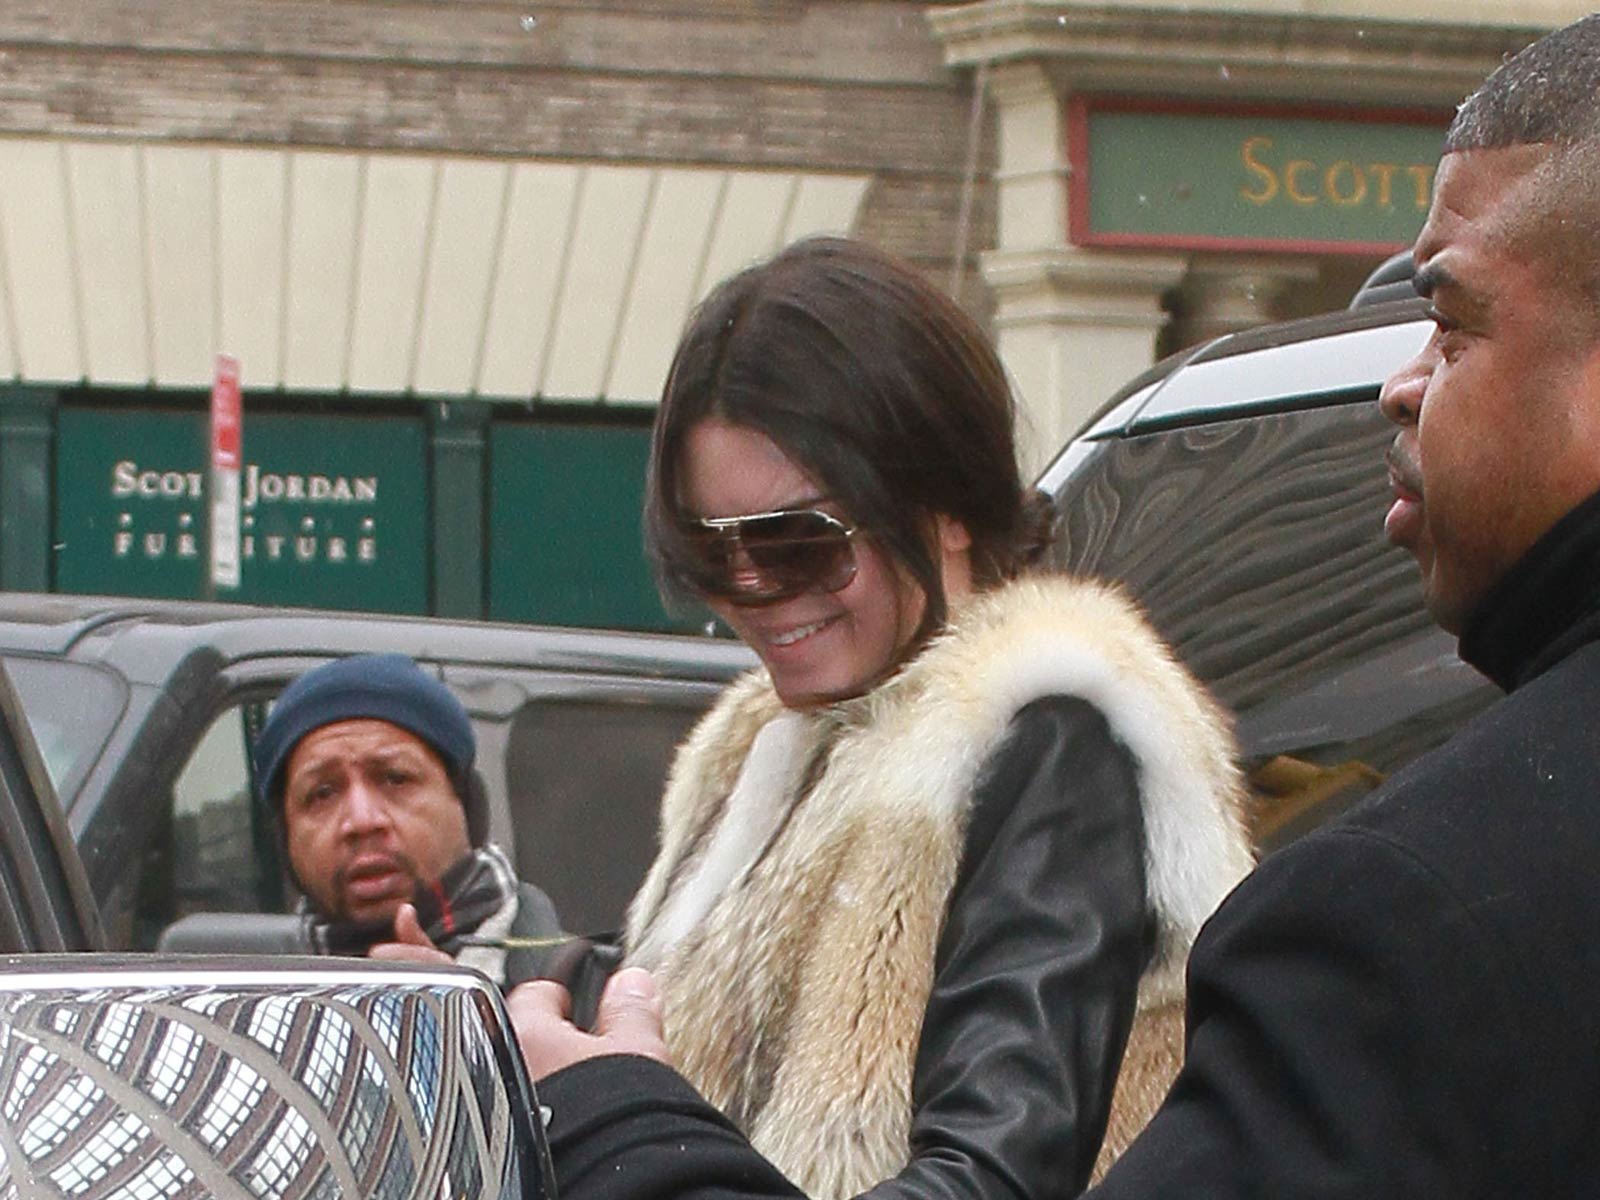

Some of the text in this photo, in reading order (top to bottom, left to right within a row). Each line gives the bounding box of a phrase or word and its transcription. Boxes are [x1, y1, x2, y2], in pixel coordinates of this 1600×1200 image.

[112, 460, 377, 508] SCOT JORDAN
[114, 531, 376, 561] FURITURE
